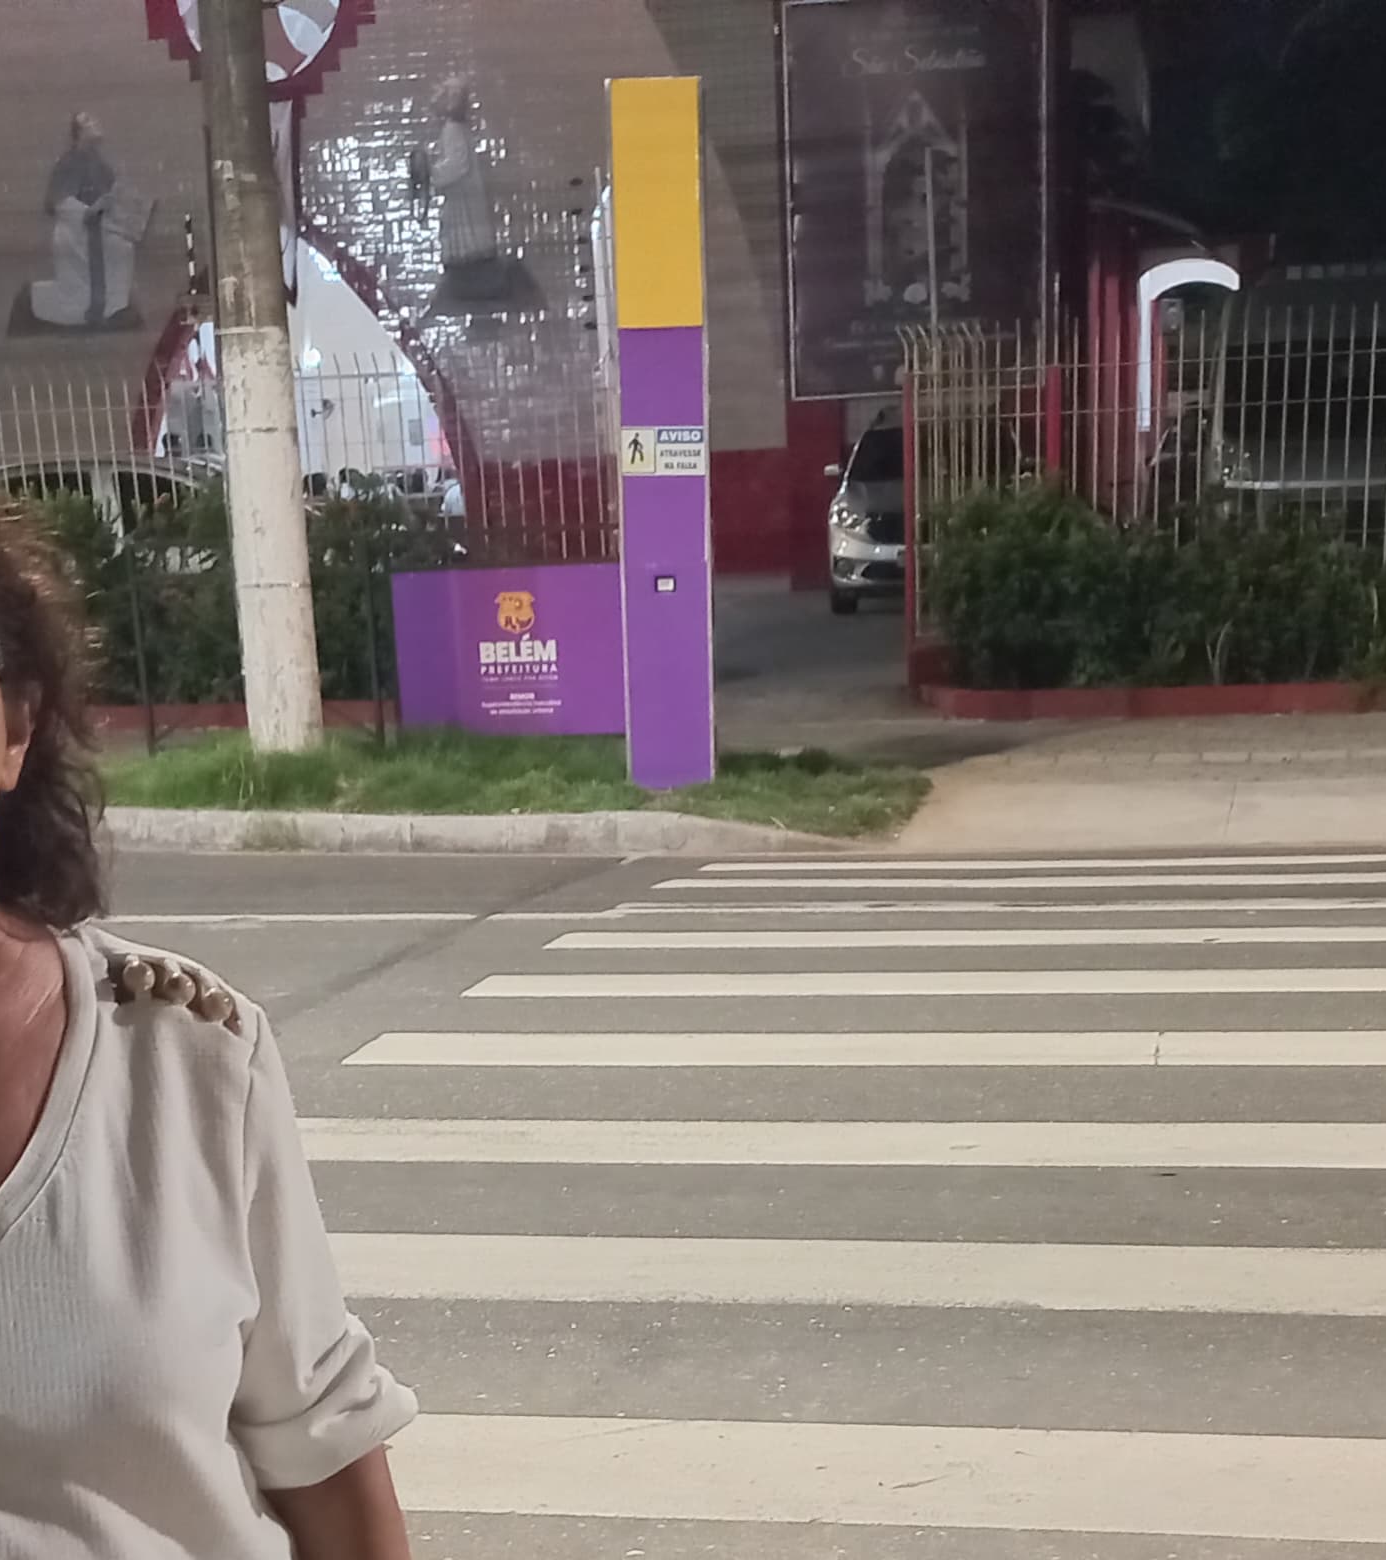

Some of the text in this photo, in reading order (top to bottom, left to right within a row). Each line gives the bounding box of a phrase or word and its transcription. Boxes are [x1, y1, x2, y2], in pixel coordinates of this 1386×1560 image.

[659, 430, 701, 442] AVISO
[479, 633, 558, 664] BELÉM
[480, 664, 558, 675] PREFEITURA
